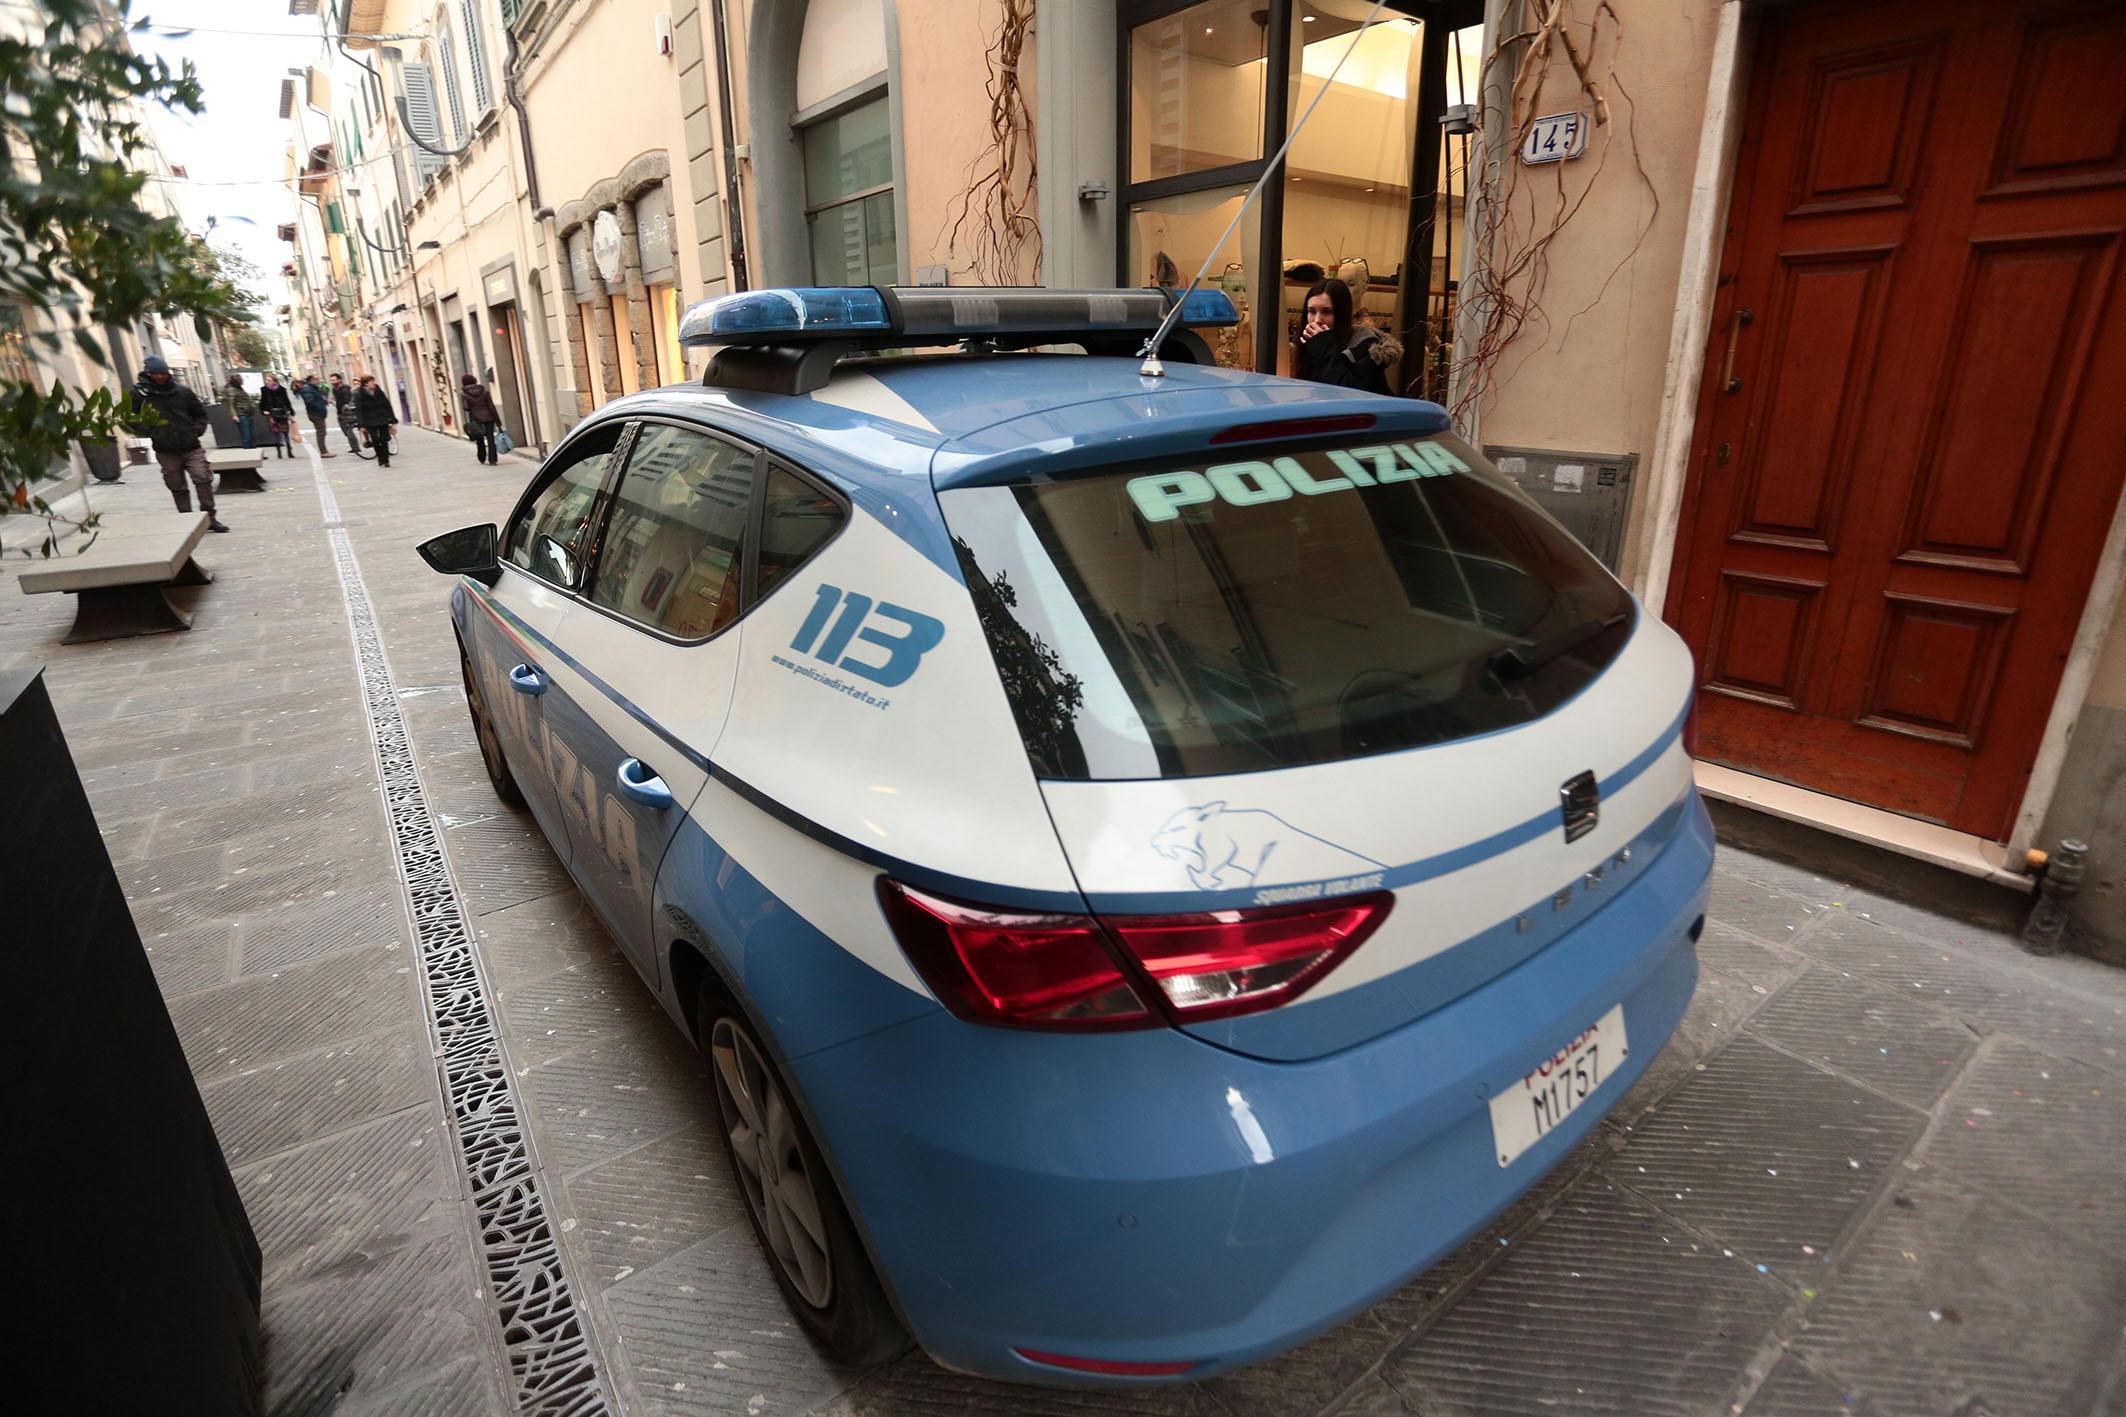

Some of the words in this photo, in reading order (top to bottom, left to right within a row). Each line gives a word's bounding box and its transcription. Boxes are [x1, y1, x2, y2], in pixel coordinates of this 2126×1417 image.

[1532, 122, 1576, 154] 145
[1126, 441, 1472, 522] POLIZIA
[790, 583, 945, 687] 113
[771, 655, 890, 711] www.poliziadistato.it
[1532, 1043, 1598, 1135] M1757
